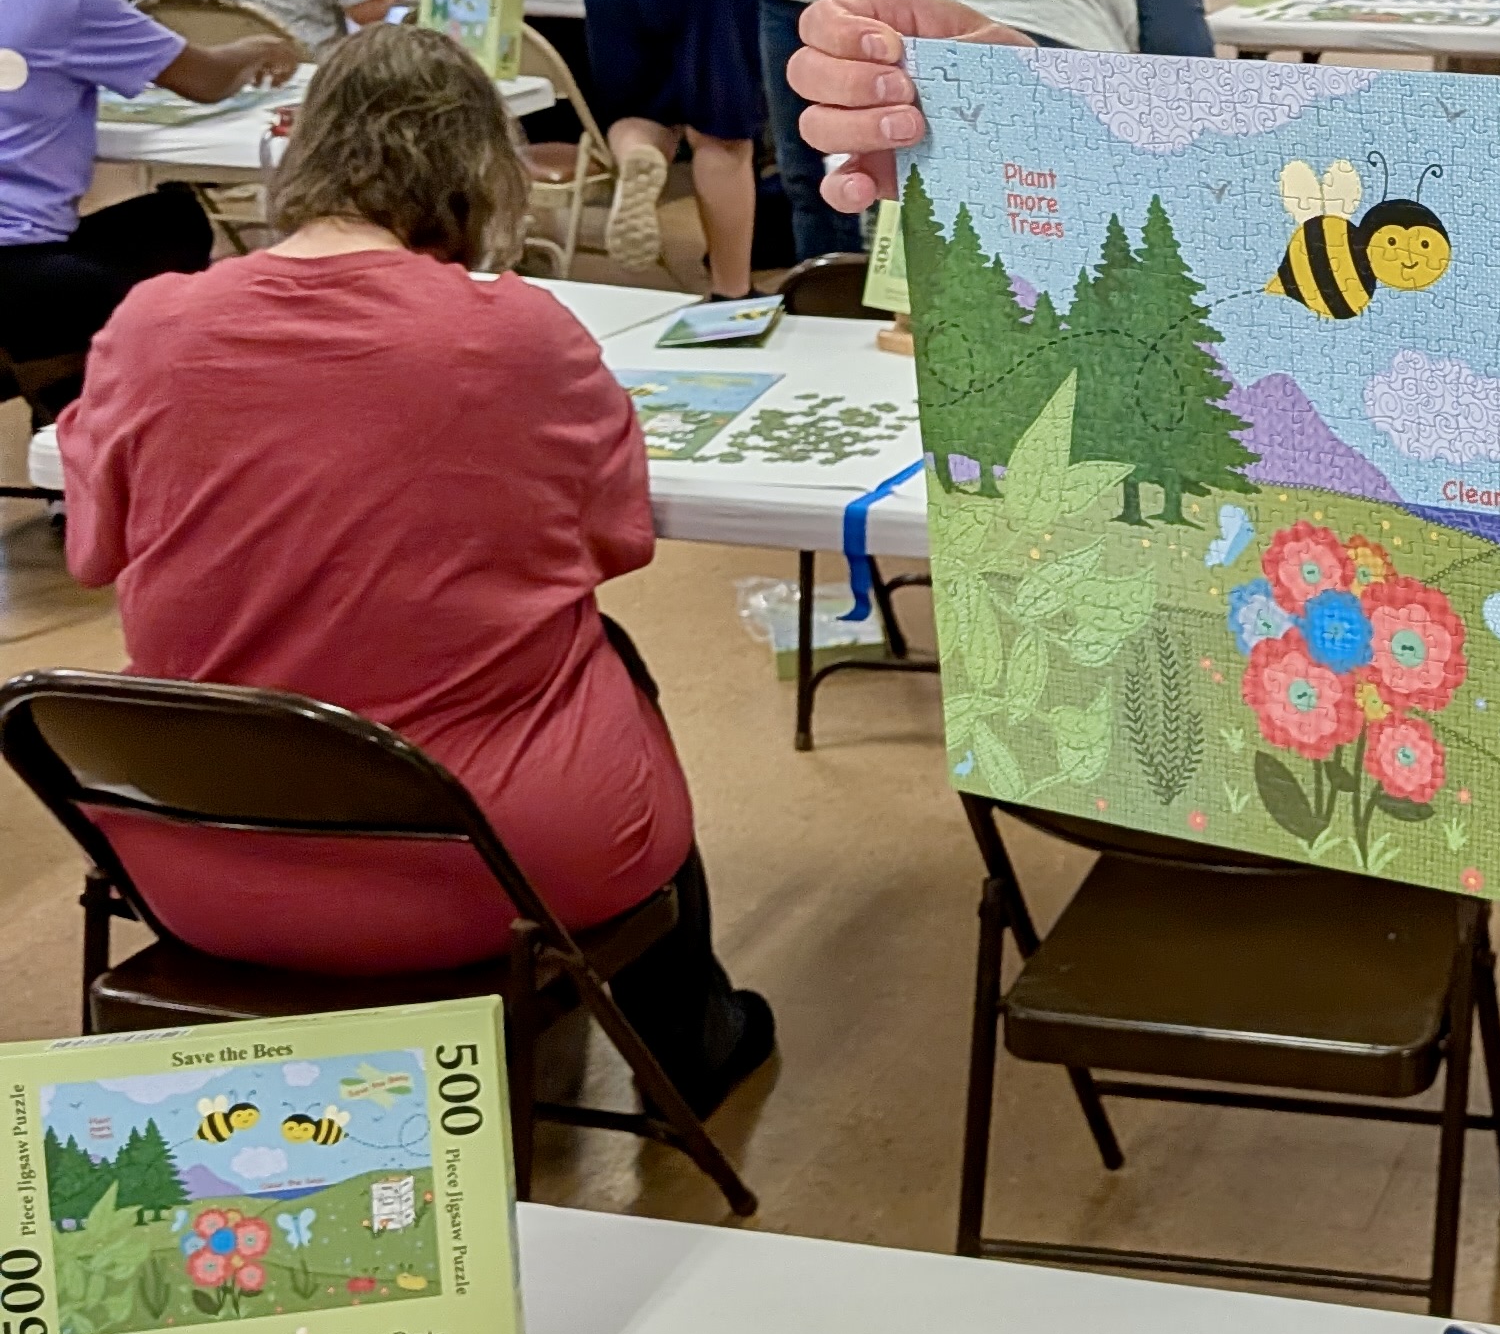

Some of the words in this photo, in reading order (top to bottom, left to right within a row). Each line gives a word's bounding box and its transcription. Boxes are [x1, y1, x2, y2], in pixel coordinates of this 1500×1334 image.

[1004, 162, 1057, 189] Plant
[1006, 193, 1059, 213] more
[1006, 212, 1065, 238] Trees
[171, 1051, 215, 1067] Save
[219, 1047, 248, 1062] the
[253, 1043, 294, 1059] Bees
[10, 1084, 28, 1136] Puzzle
[436, 1044, 484, 1136] 500
[17, 1140, 37, 1191] Jigsaw
[445, 1148, 461, 1188] Piece
[20, 1195, 37, 1236] Piece
[445, 1191, 464, 1241] Jigsaw
[452, 1245, 470, 1296] Puzzle
